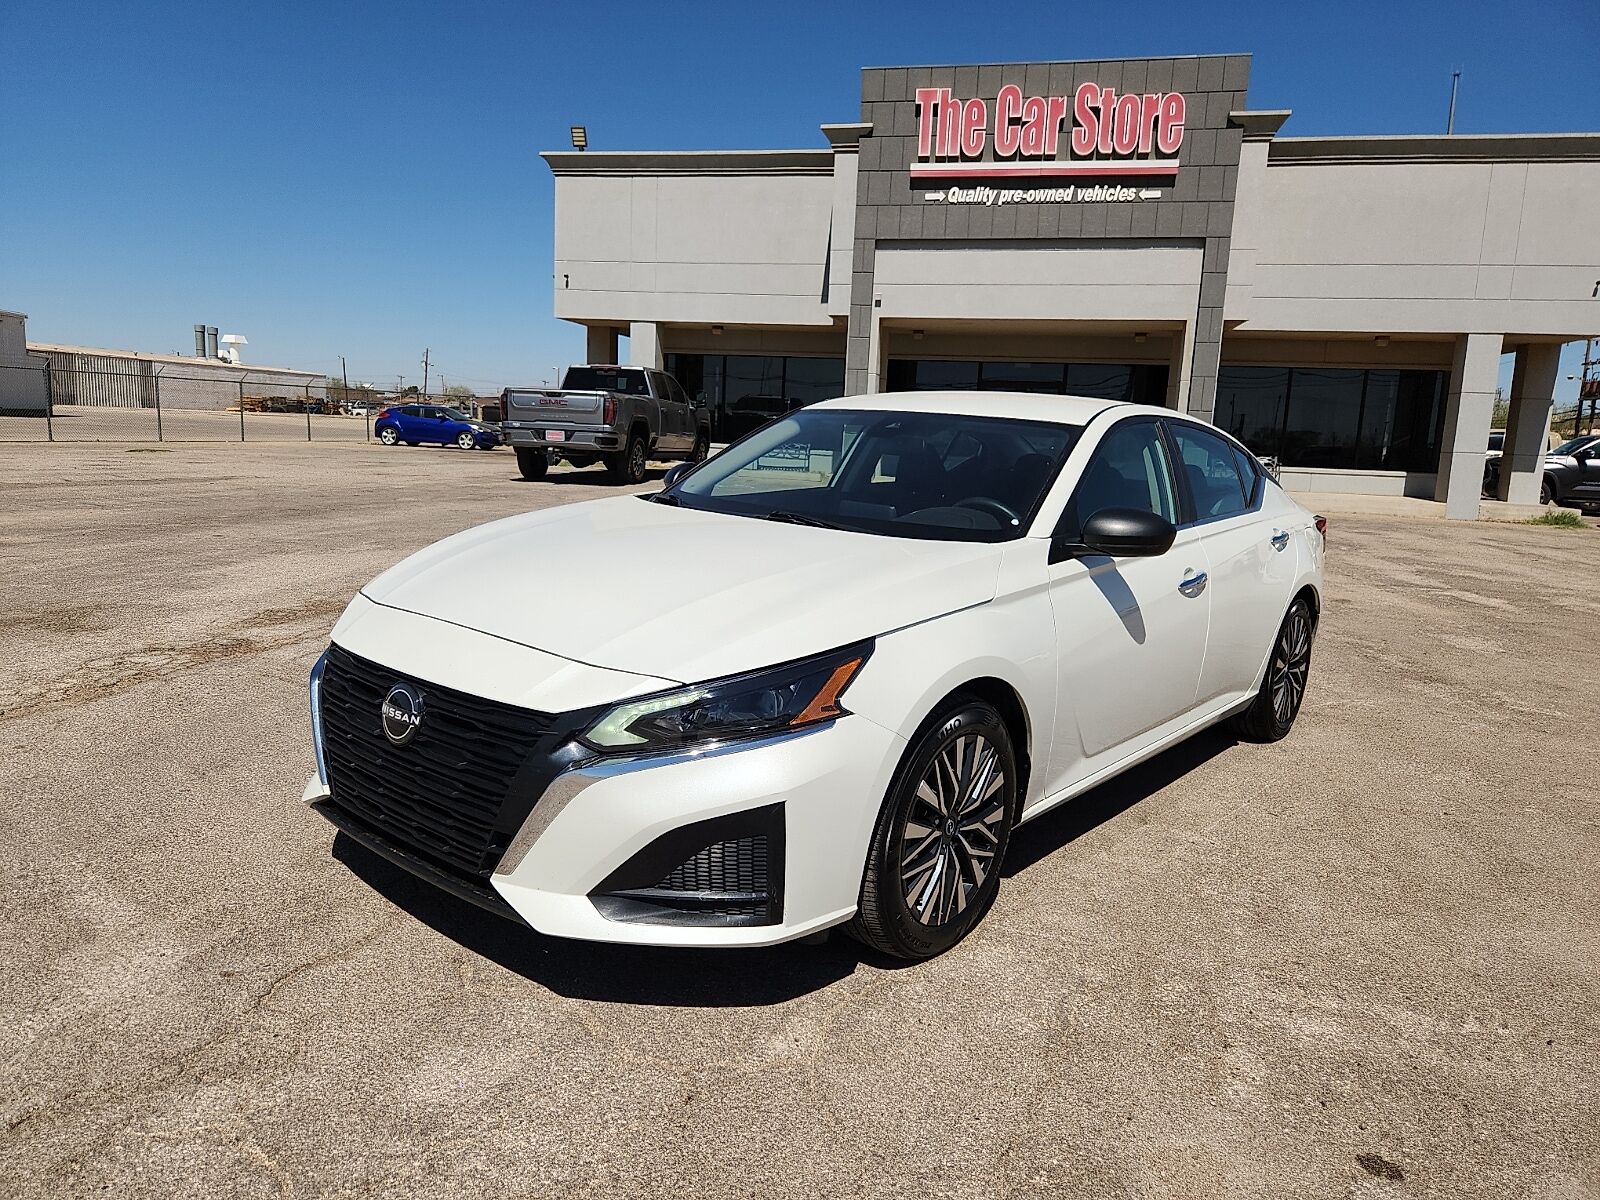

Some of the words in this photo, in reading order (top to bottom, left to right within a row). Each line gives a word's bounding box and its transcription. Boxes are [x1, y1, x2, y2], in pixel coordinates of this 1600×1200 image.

[915, 88, 987, 157] The
[994, 84, 1067, 157] Car
[1071, 82, 1186, 156] Store
[947, 186, 998, 206] Quality
[998, 185, 1074, 206] pre-owned
[1076, 184, 1137, 202] vehicles
[540, 399, 568, 407] GMC
[382, 701, 420, 726] NISSAN
